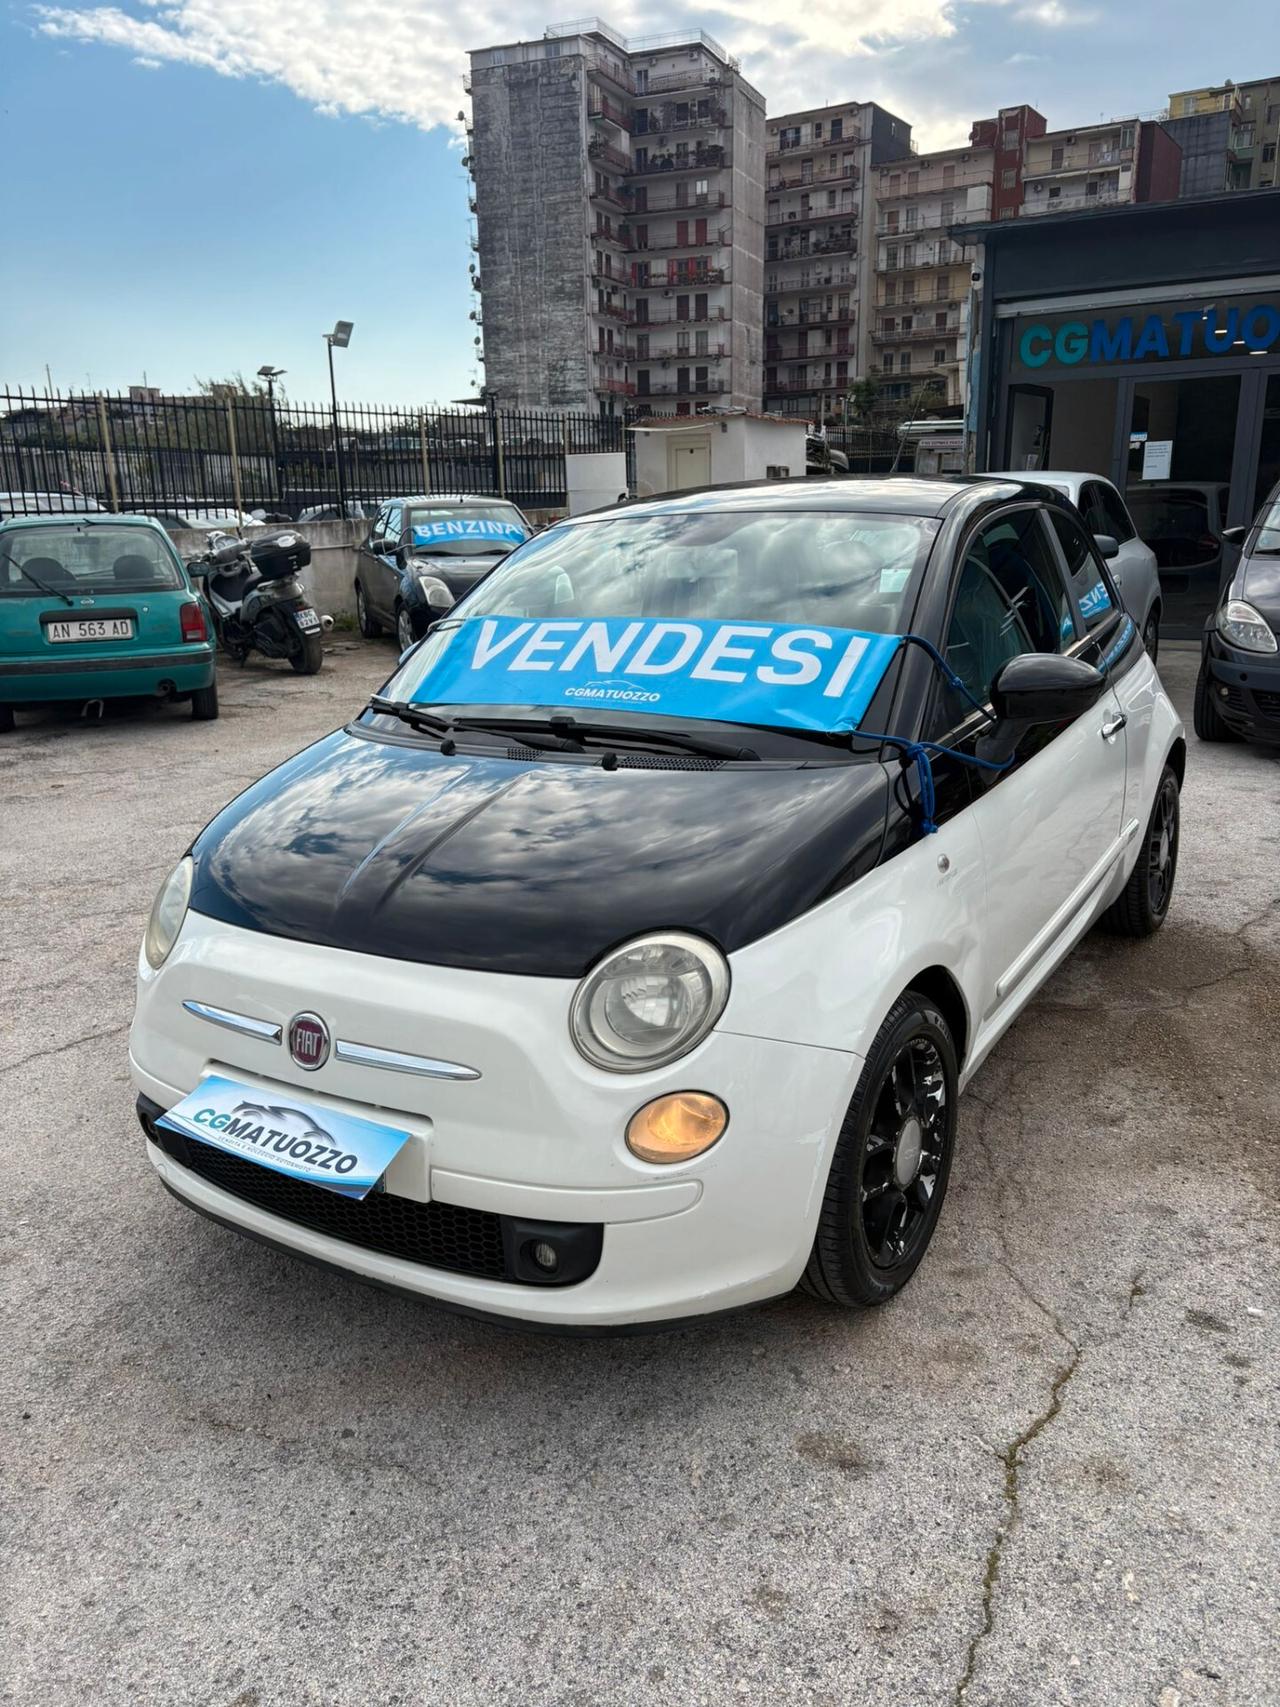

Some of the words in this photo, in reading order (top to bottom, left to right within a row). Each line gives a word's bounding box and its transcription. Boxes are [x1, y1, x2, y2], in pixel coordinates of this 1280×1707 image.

[414, 520, 524, 537] BENZINA
[53, 623, 71, 639] AN
[79, 622, 106, 637] 563
[113, 621, 129, 635] AD
[470, 619, 871, 698] VENDESI
[564, 687, 661, 702] CGMATUOZZO
[296, 1028, 321, 1057] FIAT
[192, 1108, 358, 1174] CGMATUOZZO
